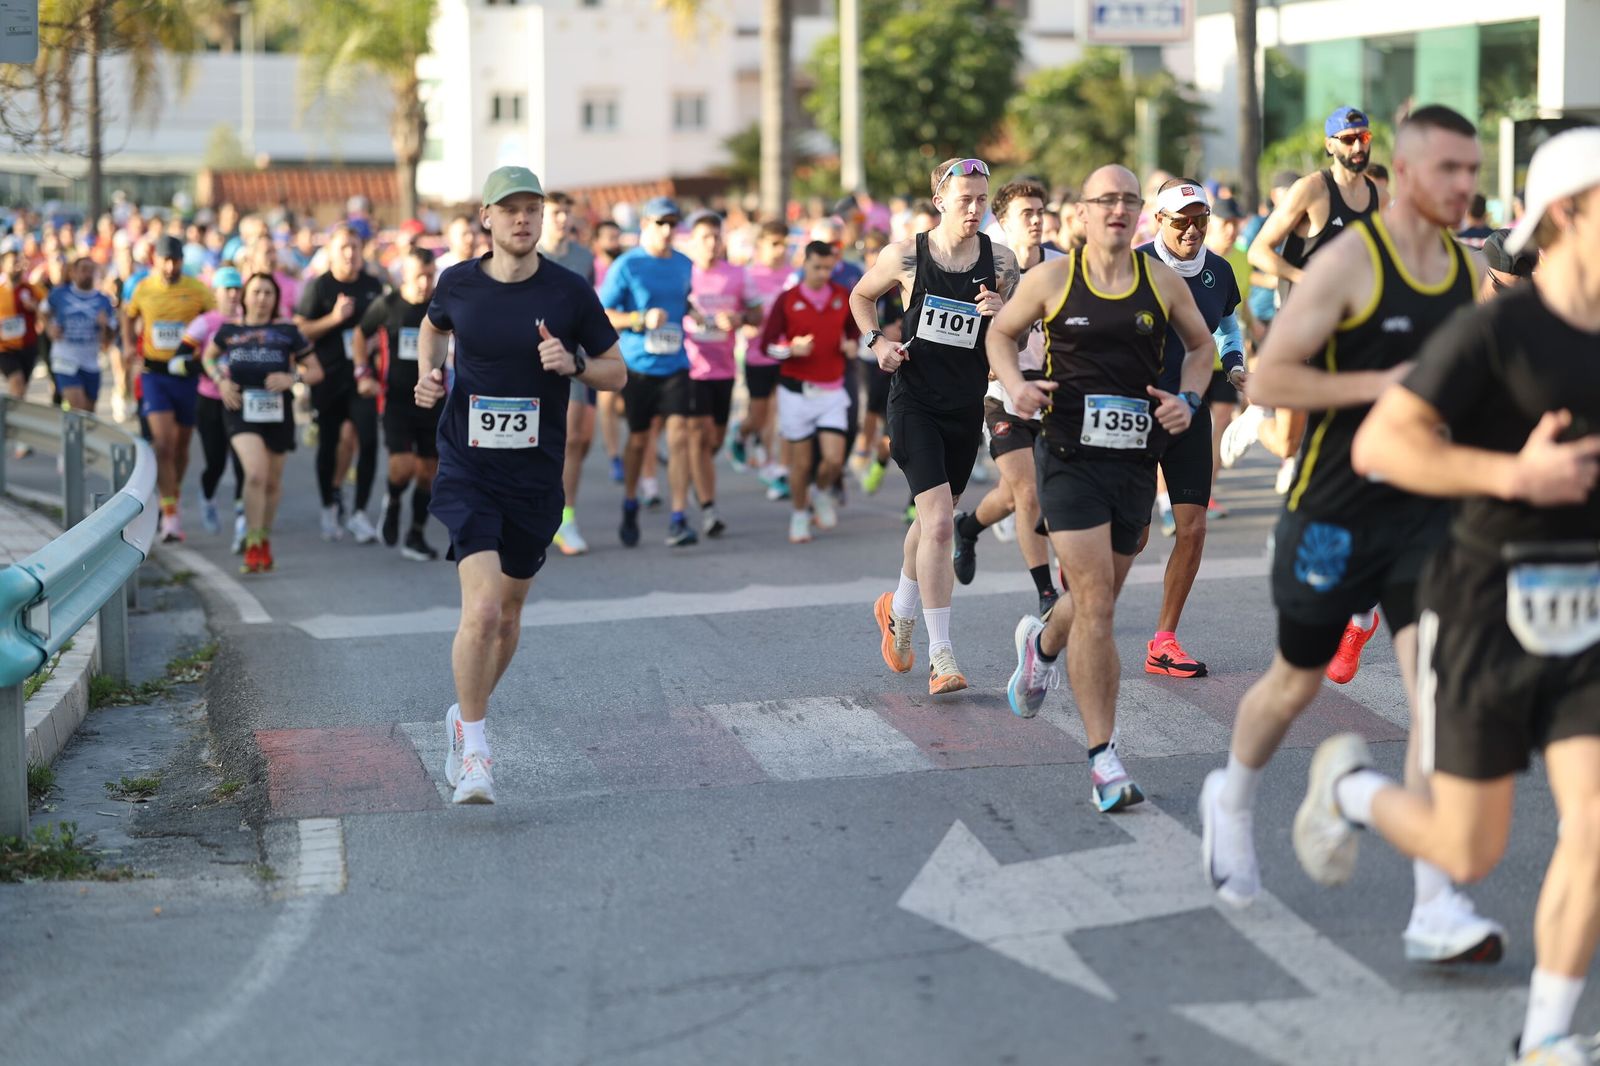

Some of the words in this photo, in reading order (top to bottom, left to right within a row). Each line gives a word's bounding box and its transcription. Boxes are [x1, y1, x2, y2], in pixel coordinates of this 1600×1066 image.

[926, 309, 975, 334] 1101
[481, 412, 527, 432] 973
[1091, 409, 1149, 433] 1359
